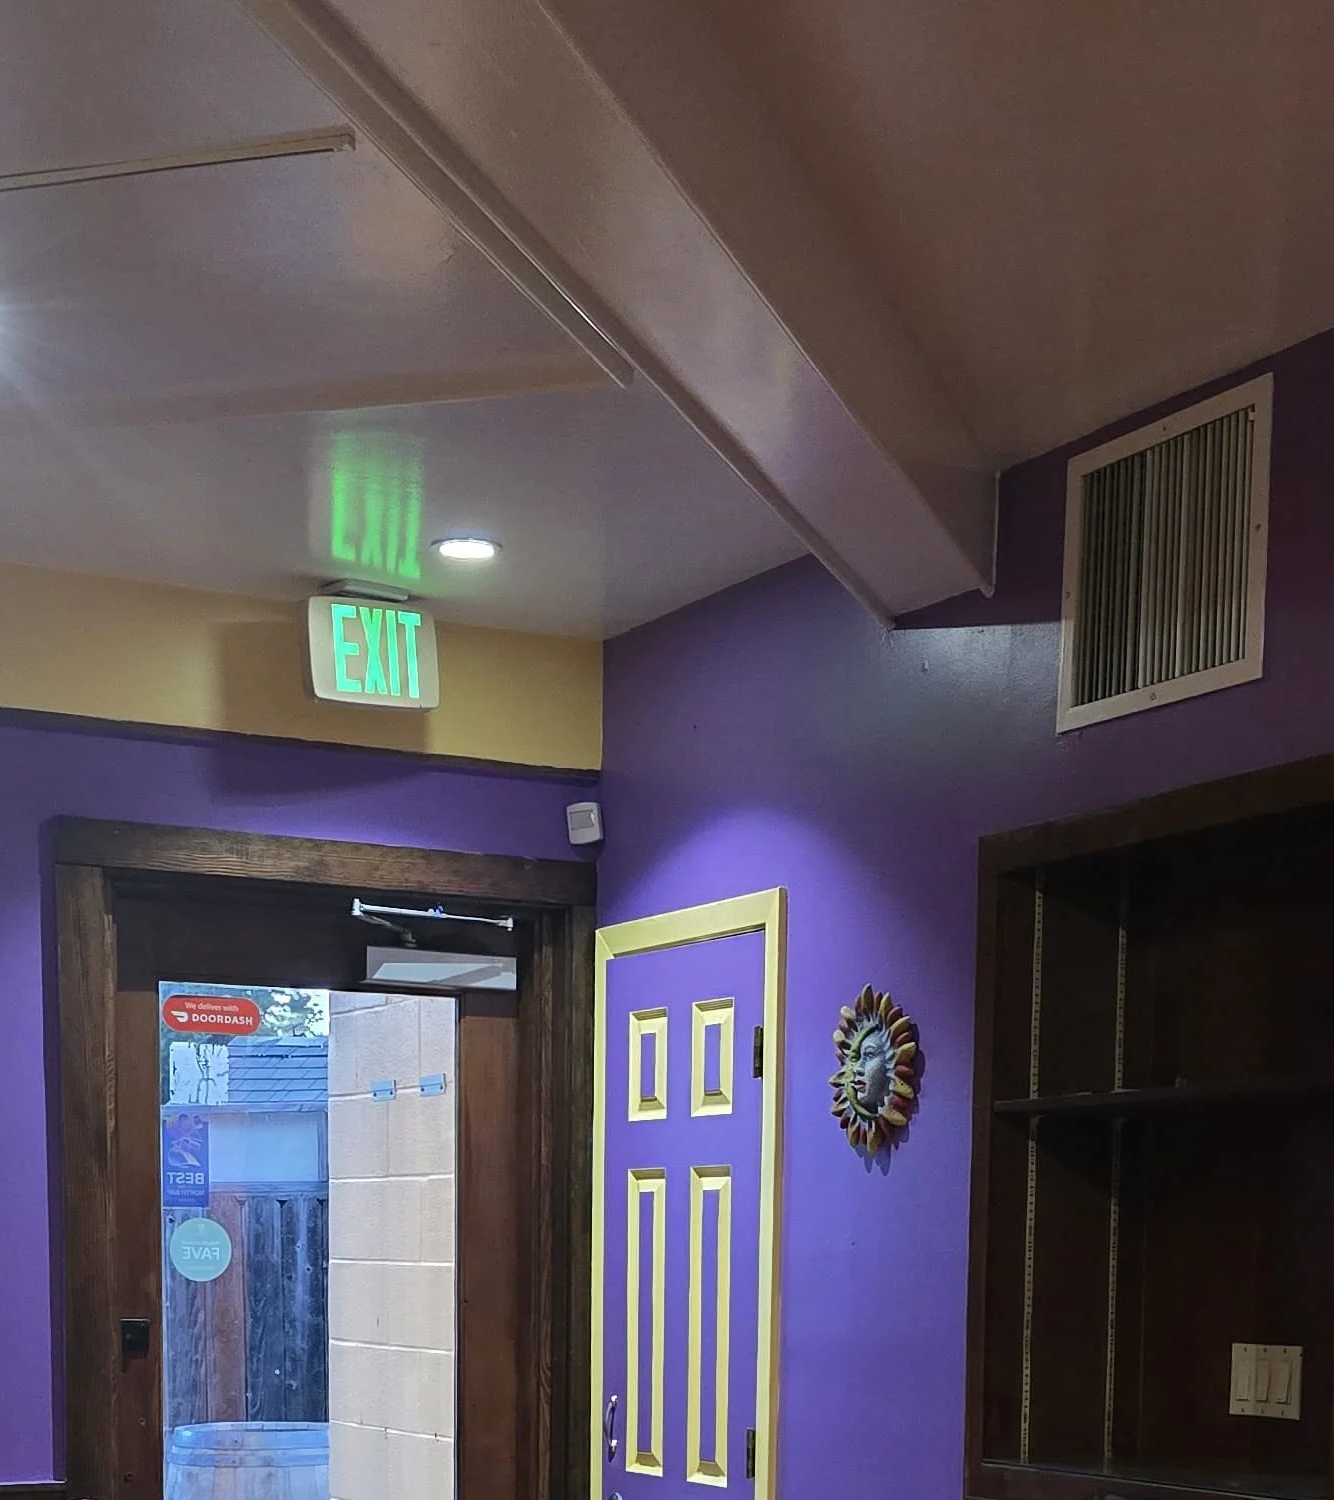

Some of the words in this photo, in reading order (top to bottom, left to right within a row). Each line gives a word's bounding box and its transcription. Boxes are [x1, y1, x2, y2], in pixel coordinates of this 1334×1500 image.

[330, 603, 421, 698] EXIT
[184, 1001, 197, 1010] We
[197, 1003, 222, 1011] deliver
[222, 1004, 239, 1012] with
[192, 1013, 253, 1026] DOORDASH
